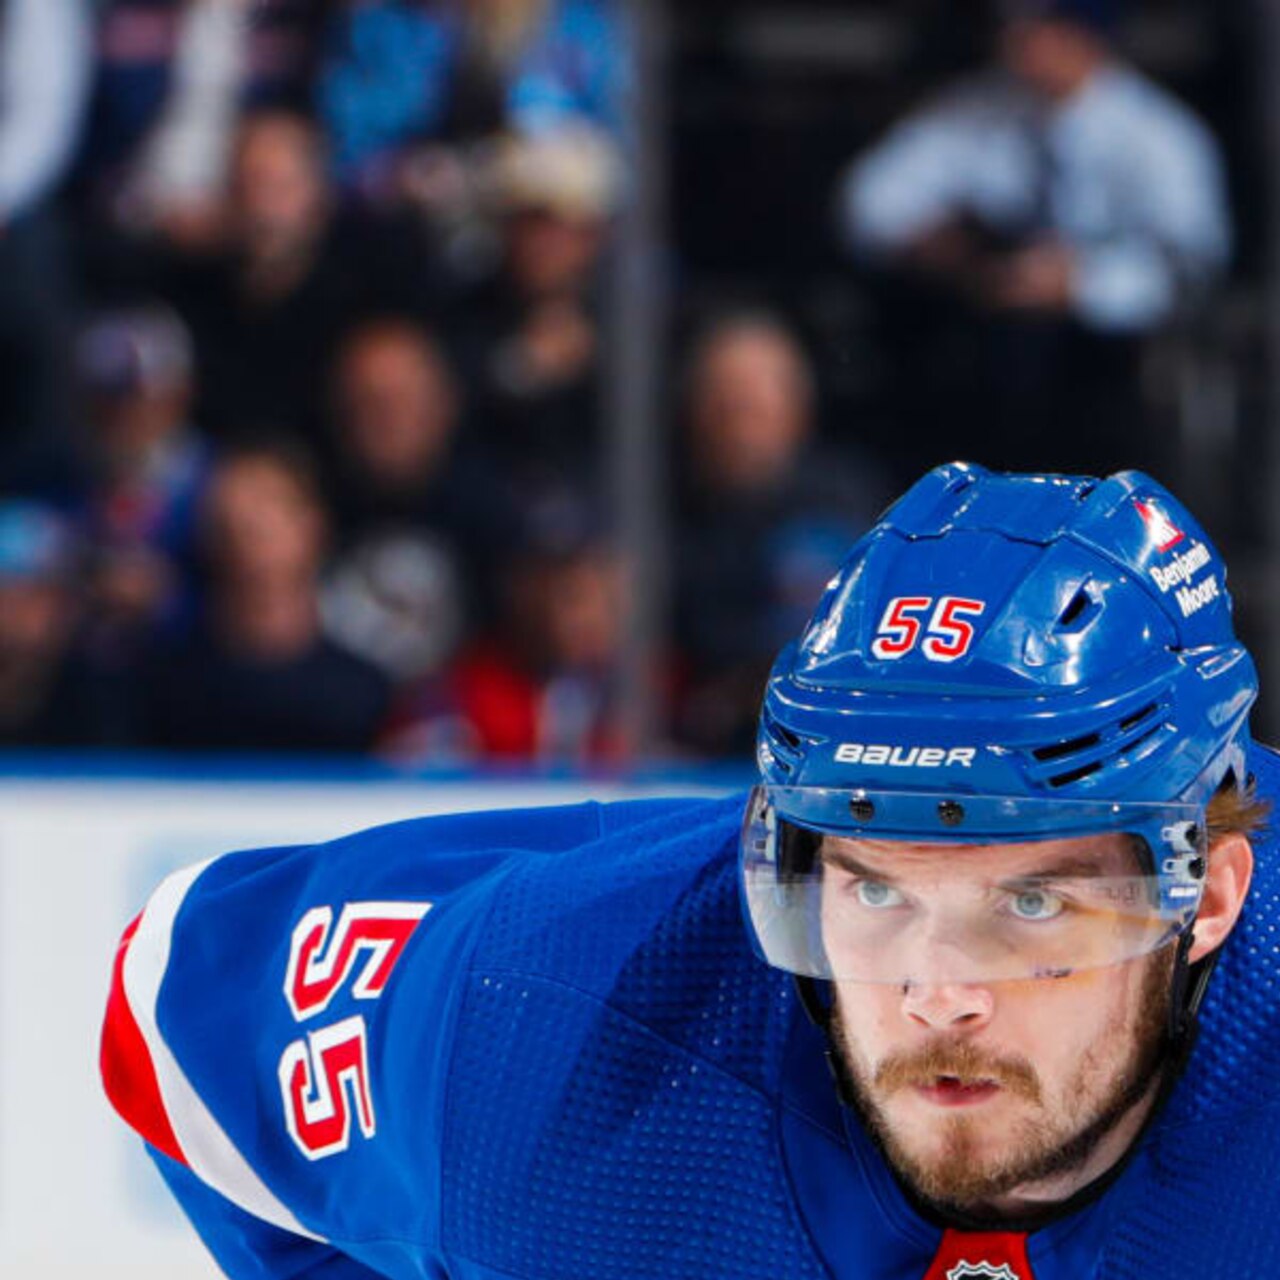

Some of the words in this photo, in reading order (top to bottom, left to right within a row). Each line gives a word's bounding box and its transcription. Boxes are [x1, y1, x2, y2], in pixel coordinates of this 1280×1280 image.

[1149, 538, 1212, 593] Benjamin
[1175, 573, 1219, 618] Moore
[871, 597, 984, 662] 55
[834, 743, 976, 768] BAUER
[277, 900, 434, 1162] 55
